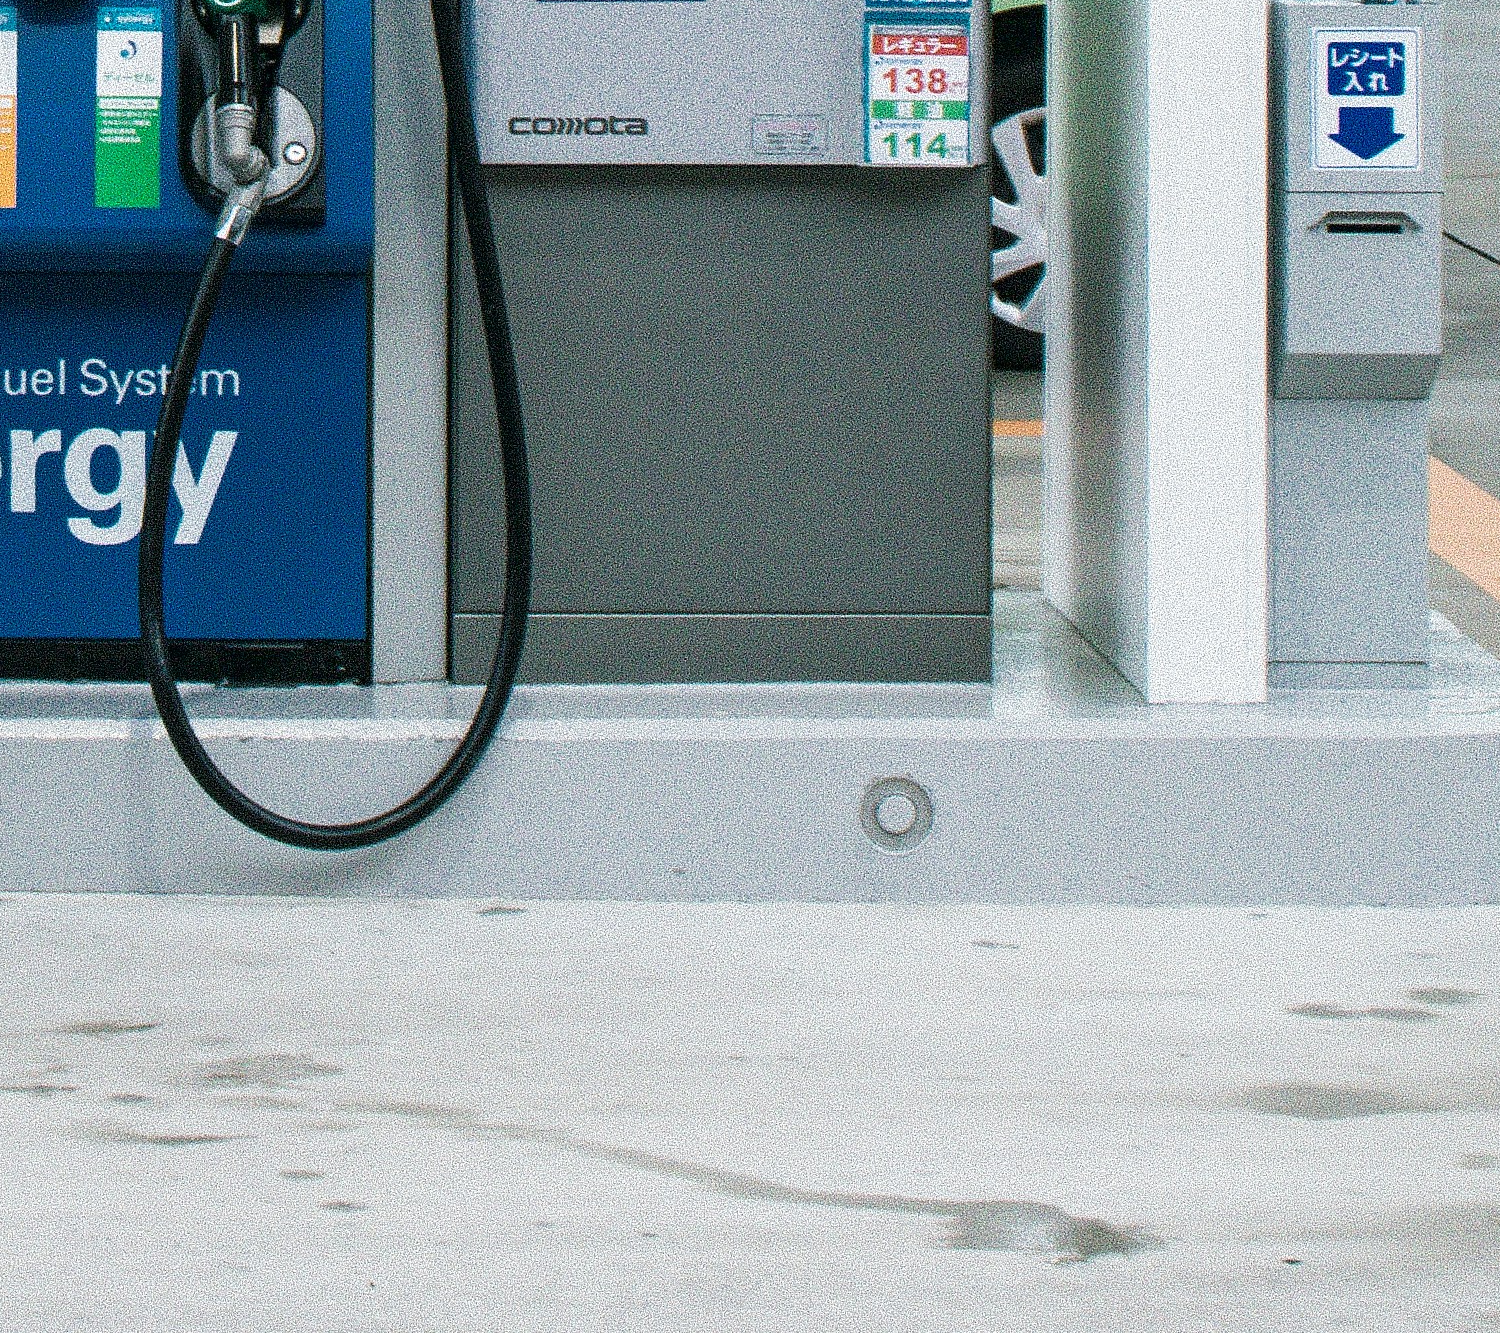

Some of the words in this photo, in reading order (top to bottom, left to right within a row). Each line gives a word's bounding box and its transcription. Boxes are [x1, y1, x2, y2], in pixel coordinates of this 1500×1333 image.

[882, 37, 957, 53] レギュラー
[1330, 46, 1405, 69] レシート
[881, 68, 949, 94] 138
[1343, 71, 1390, 93] 入れ
[881, 132, 949, 159] 114
[79, 357, 241, 406] Systm
